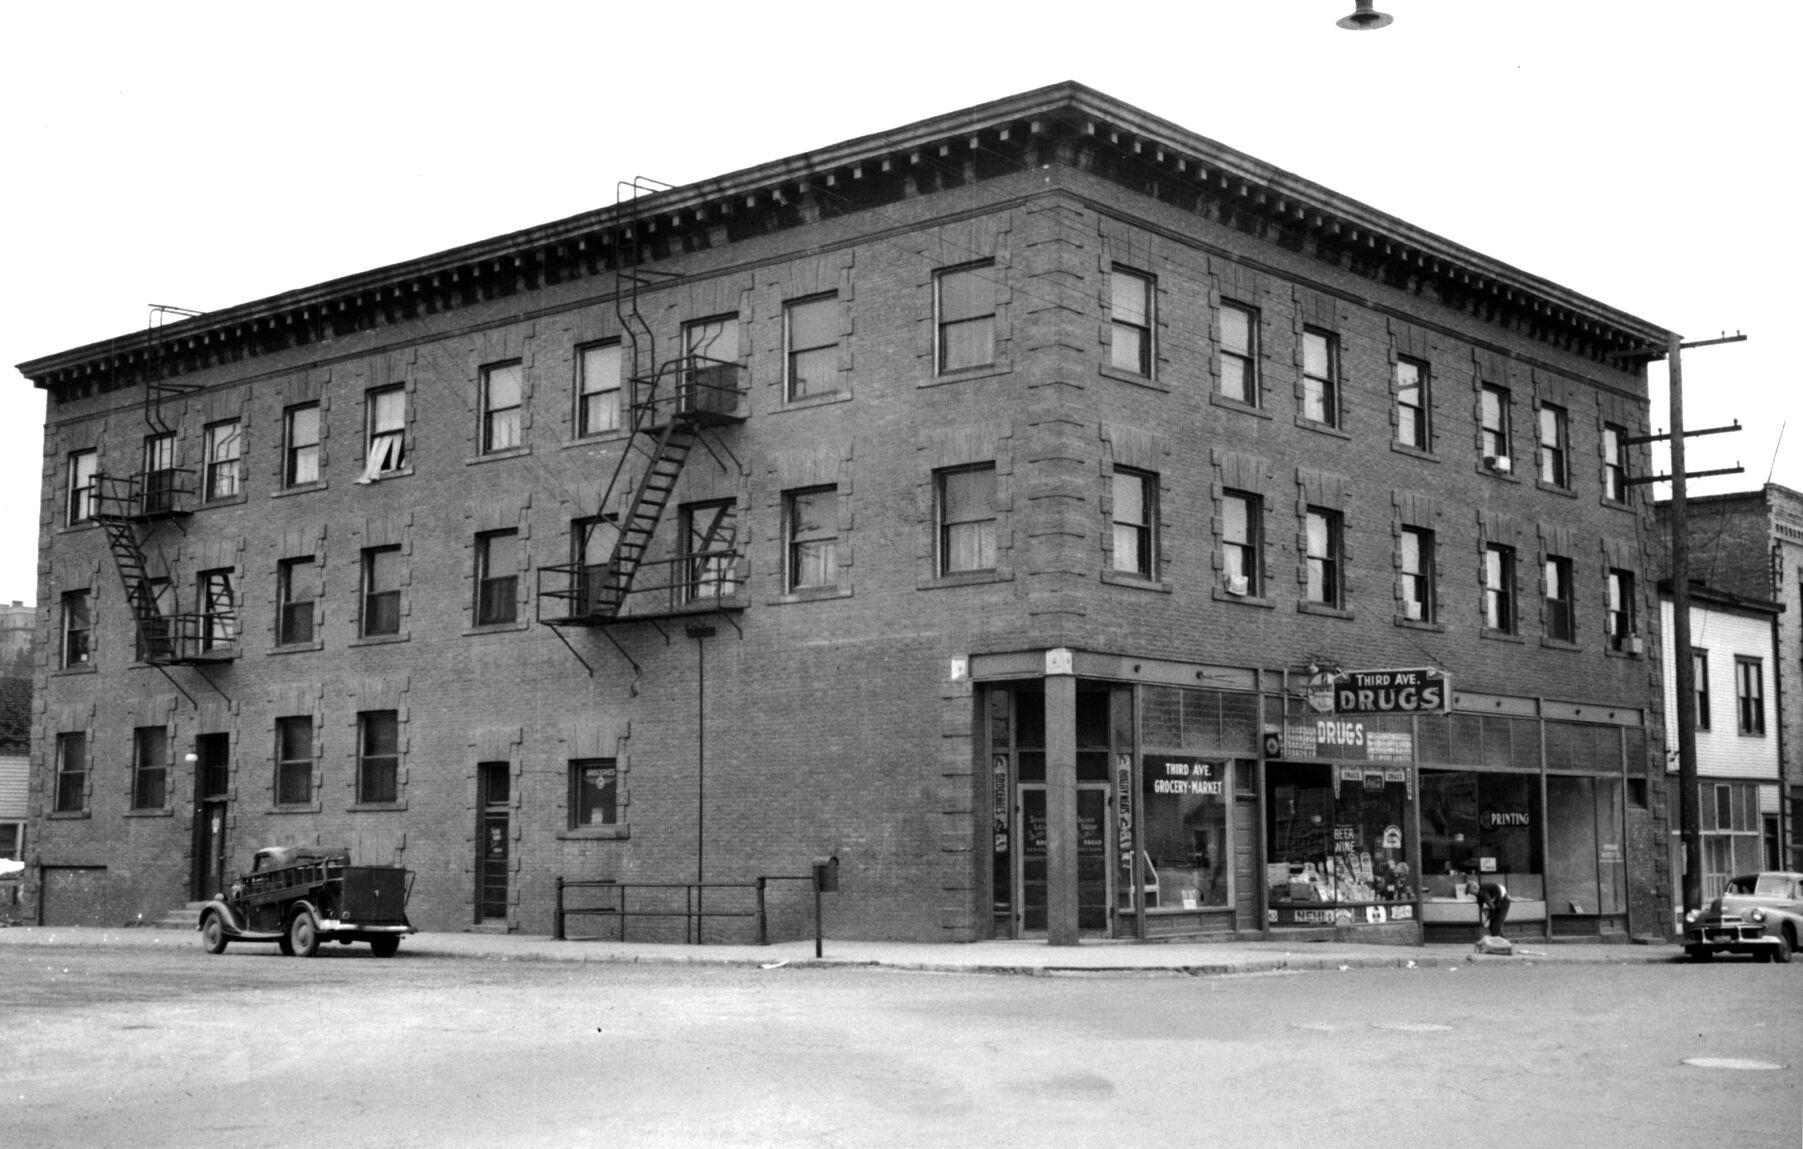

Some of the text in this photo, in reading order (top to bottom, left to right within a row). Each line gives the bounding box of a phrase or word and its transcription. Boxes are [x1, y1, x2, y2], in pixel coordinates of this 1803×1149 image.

[1356, 673, 1420, 686] THIRD AVE.
[1340, 687, 1440, 710] DRUGS
[1317, 720, 1363, 746] DRUGS
[1165, 763, 1212, 776] THIRD AVE.
[1491, 812, 1529, 825] PRINTING
[1334, 828, 1354, 839] BEER
